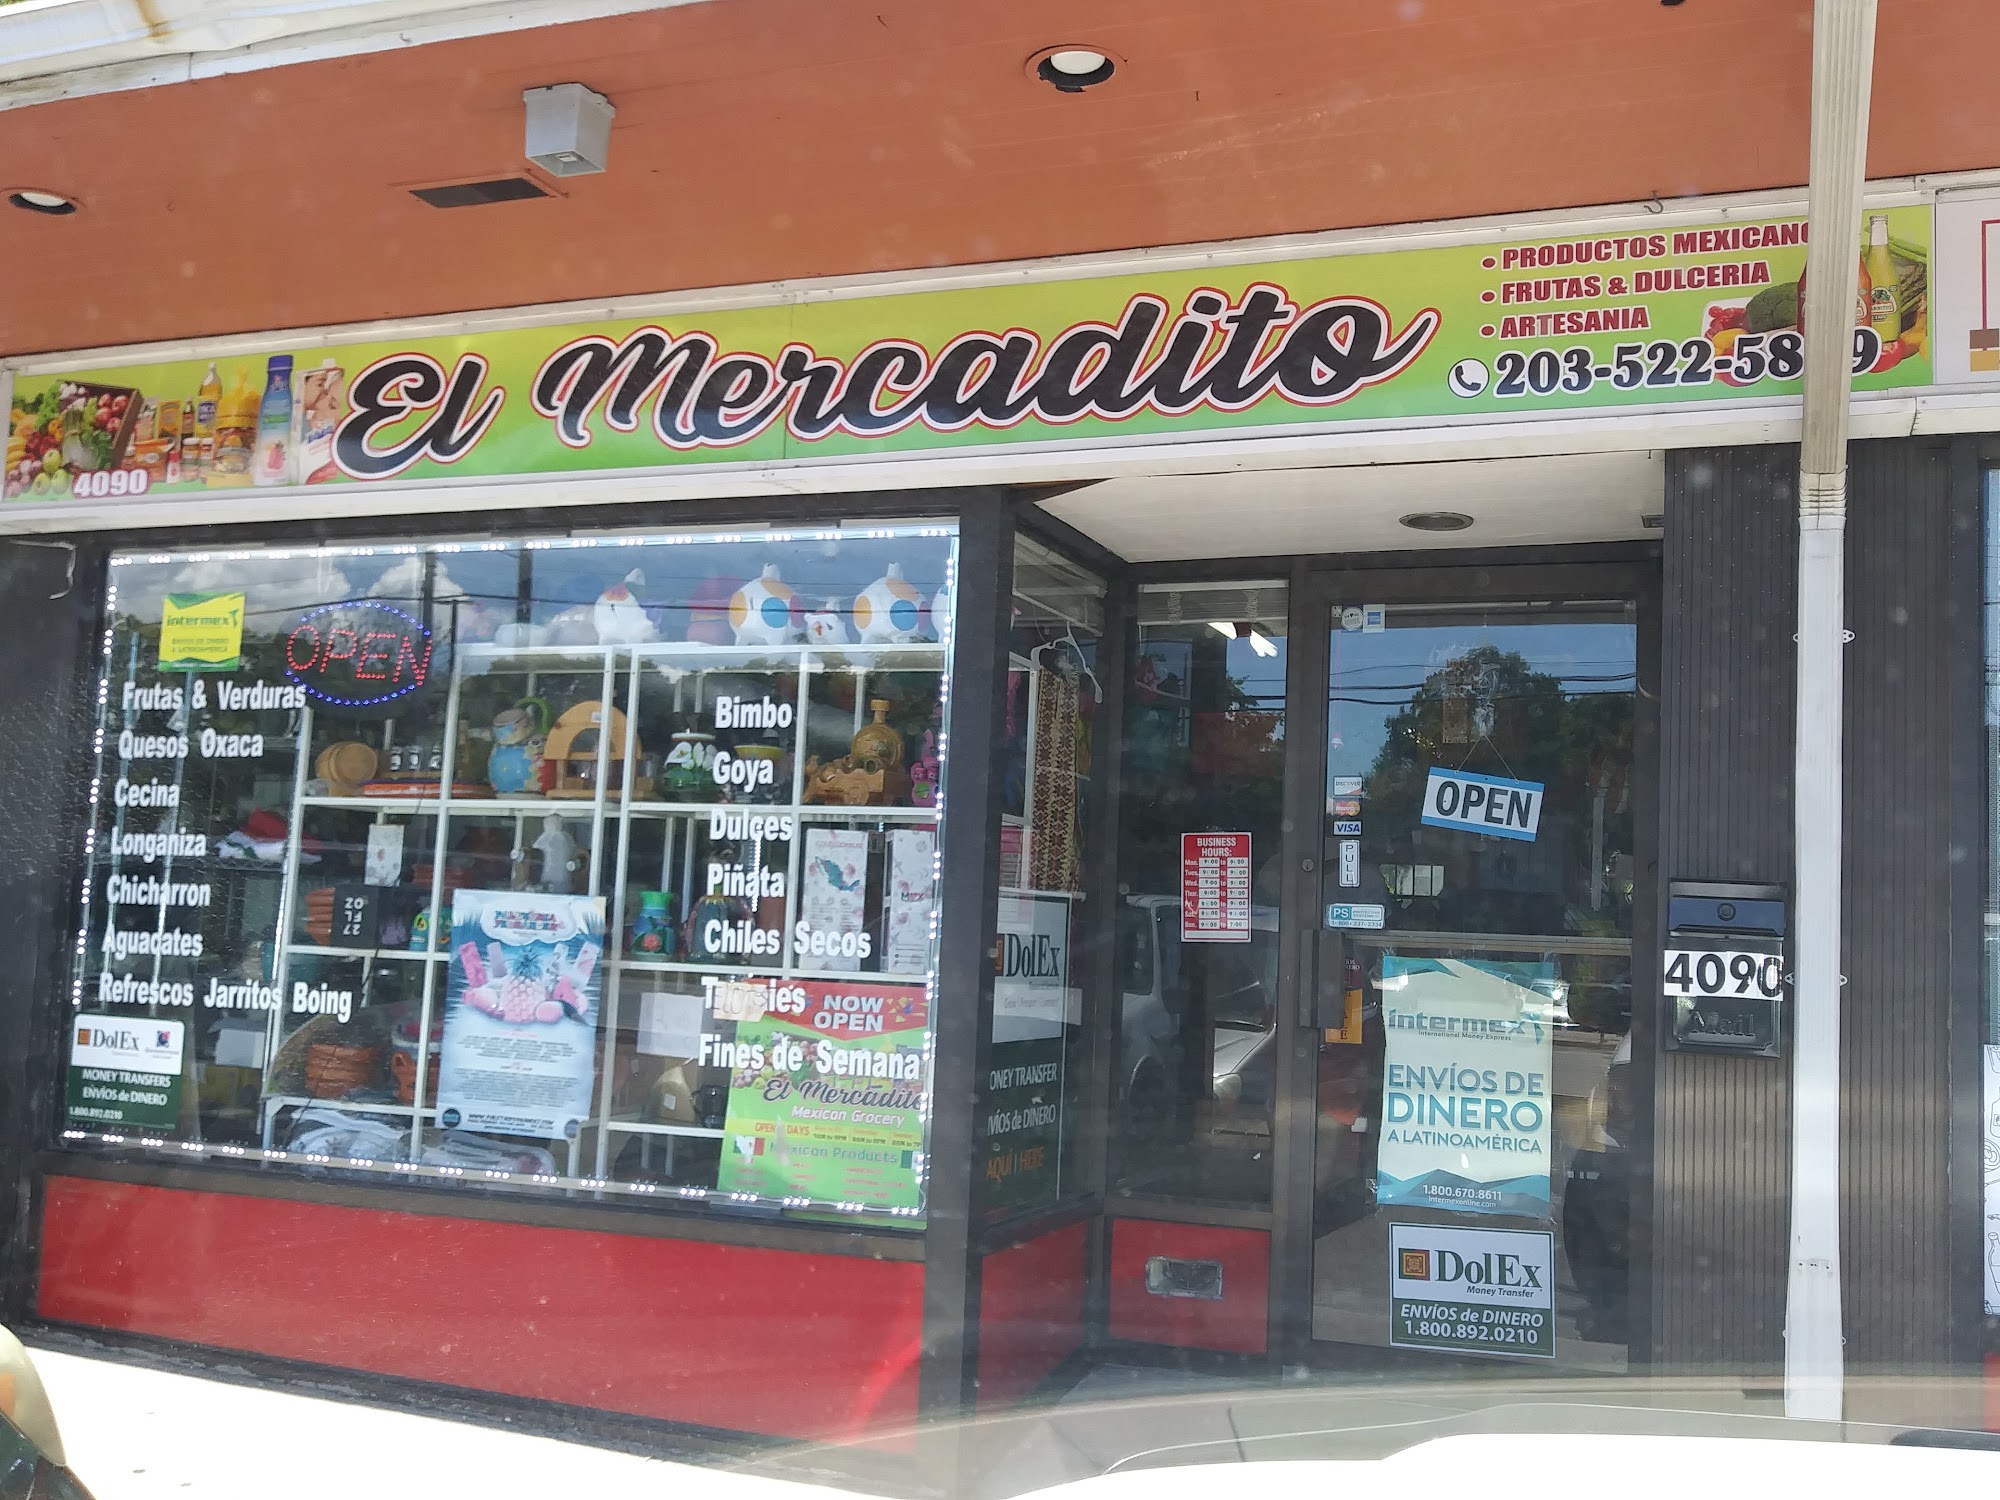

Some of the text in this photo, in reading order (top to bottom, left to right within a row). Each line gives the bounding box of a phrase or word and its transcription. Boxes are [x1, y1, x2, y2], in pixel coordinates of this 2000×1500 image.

[1502, 234, 1666, 269] PRODUCTOS
[1502, 262, 1770, 303] FRUTAS & DULCERIA
[1500, 308, 1648, 338] ARTESANIA
[1495, 330, 1879, 396] 203-522-589
[333, 283, 1440, 478] El Mercadito
[73, 470, 147, 497] 4090
[287, 625, 432, 686] OPEN
[122, 680, 306, 710] Frutas & Verduras
[715, 696, 792, 728] Bimbo
[119, 728, 263, 759] Quesos Oxaca
[712, 751, 773, 792] Goya
[115, 779, 180, 807] Cecina
[1435, 780, 1533, 828] OPEN
[710, 808, 793, 841] Dulces
[1336, 823, 1360, 832] VISA
[111, 826, 206, 862] Longaniza
[1197, 837, 1236, 847] BUSINESS
[1202, 848, 1232, 857] HOURS:
[1345, 844, 1354, 883] PULL
[107, 875, 211, 908] Chicharron
[707, 863, 785, 898] Piñata
[1333, 908, 1349, 918] PS
[102, 927, 204, 961] Aguacates
[704, 919, 780, 954] Chiles
[794, 920, 871, 958] Secos
[1006, 933, 1060, 978] DolEx
[1665, 952, 1783, 998] 4090
[98, 972, 352, 1023] Refrescos Jarritos Boing
[823, 994, 885, 1013] NOW
[813, 1012, 883, 1033] OPEN
[1388, 1008, 1526, 1035] intermex
[1418, 1030, 1511, 1042] International Money Express
[93, 1029, 139, 1051] DolEx
[699, 1034, 919, 1079] Fines de Semana
[82, 1069, 171, 1087] MONEY TRANSFERS
[989, 1062, 1058, 1091] ONEY TRANSFER
[1388, 1062, 1544, 1096] ENVÍOS DE
[82, 1085, 168, 1106] ENVÍOS de DINERO
[763, 1079, 923, 1111] El Mercadito
[791, 1105, 905, 1127] Mexican Grocery
[987, 1103, 1057, 1136] VÍOS de DINERO
[1387, 1093, 1543, 1133] DINERO
[787, 1125, 810, 1137] DAYS
[1387, 1129, 1542, 1153] A LATINOAMÉRICA
[833, 1147, 897, 1164] Products
[1423, 1184, 1503, 1200] 1.800.670.8611
[1428, 1195, 1497, 1209] intermexonline.com
[1435, 1249, 1543, 1289] DolEx
[1466, 1285, 1535, 1299] Money Transfer
[1400, 1303, 1544, 1328] ENVÍOS de DINERO
[1405, 1321, 1538, 1345] 1.800.892.0210
